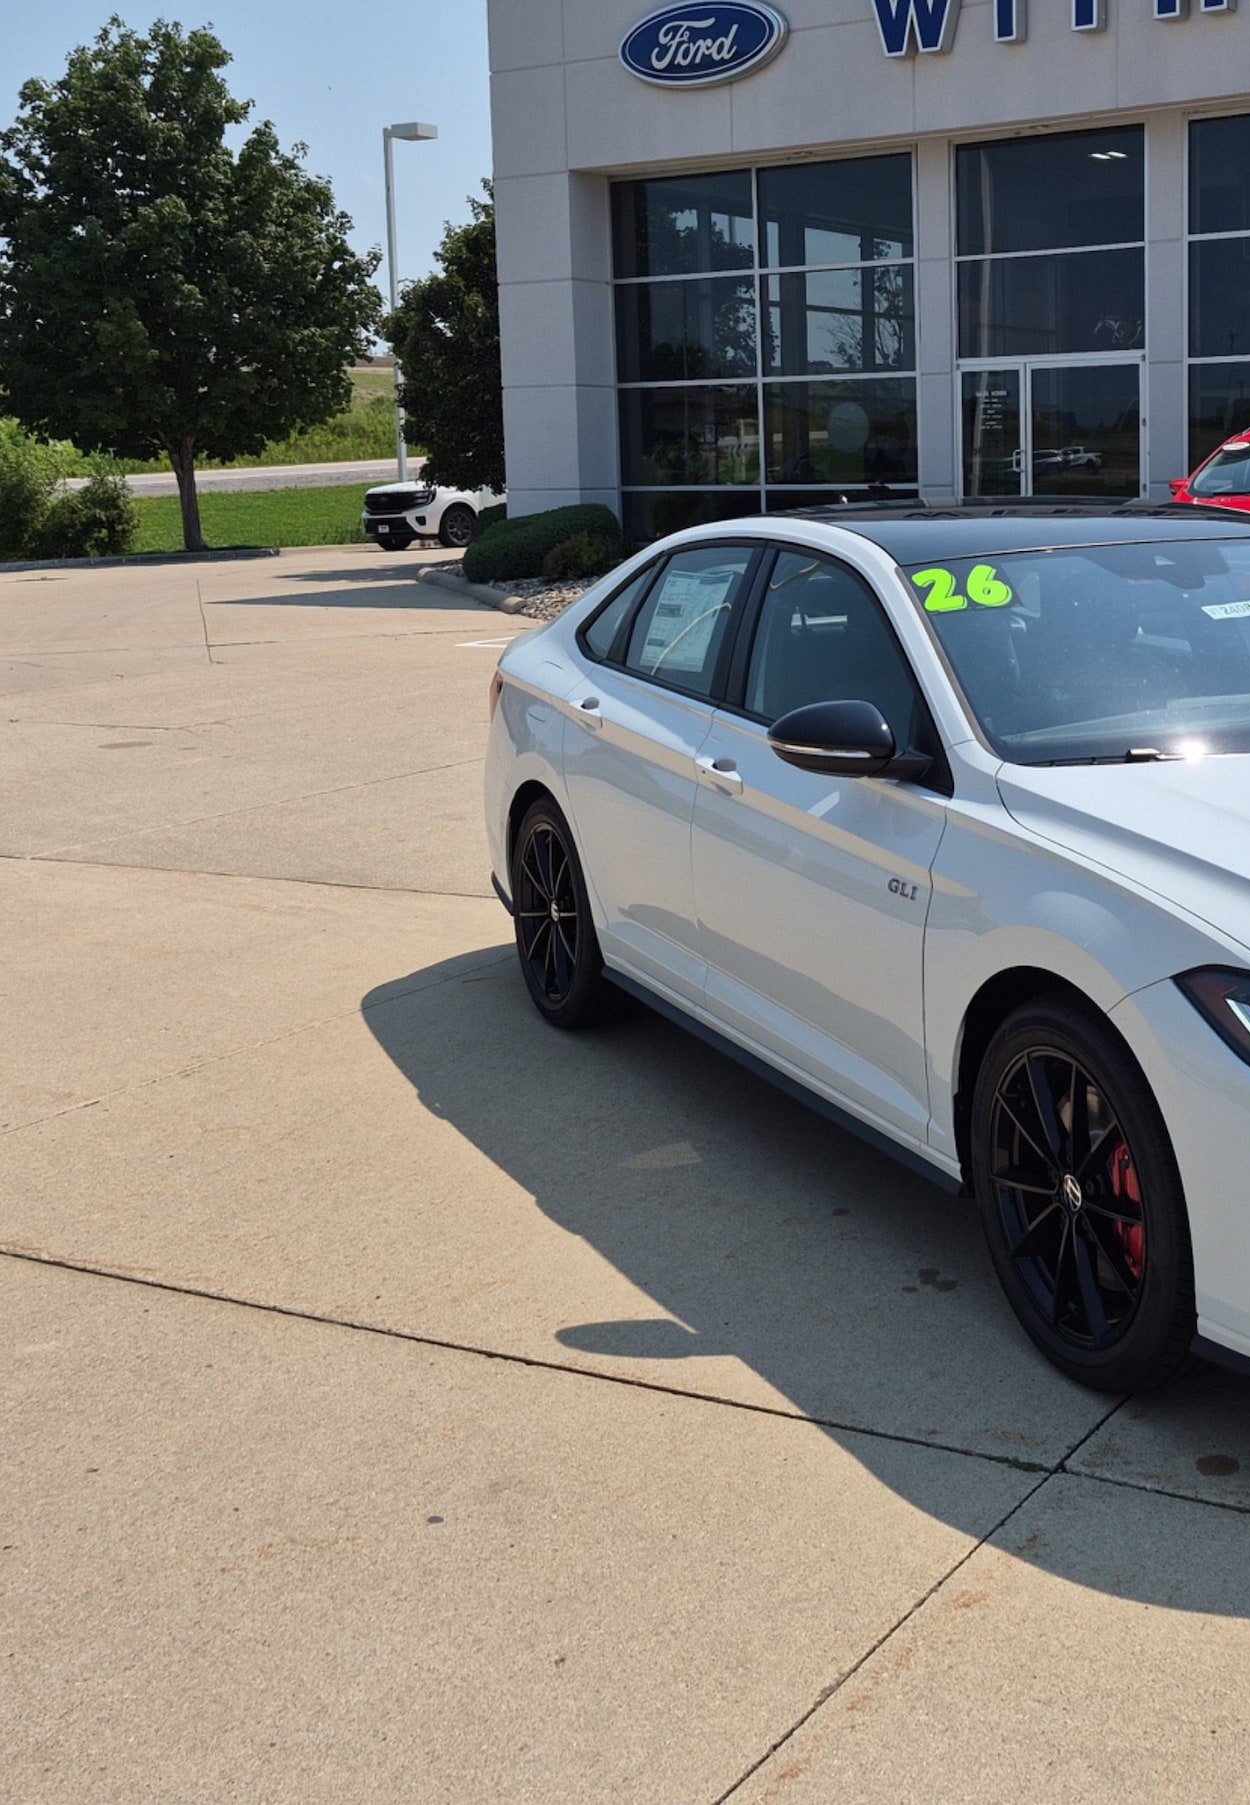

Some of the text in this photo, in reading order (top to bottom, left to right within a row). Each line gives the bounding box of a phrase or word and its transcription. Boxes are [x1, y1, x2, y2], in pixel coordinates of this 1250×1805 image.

[651, 16, 739, 70] Ford
[911, 564, 1012, 613] 26
[887, 878, 918, 900] GLI
